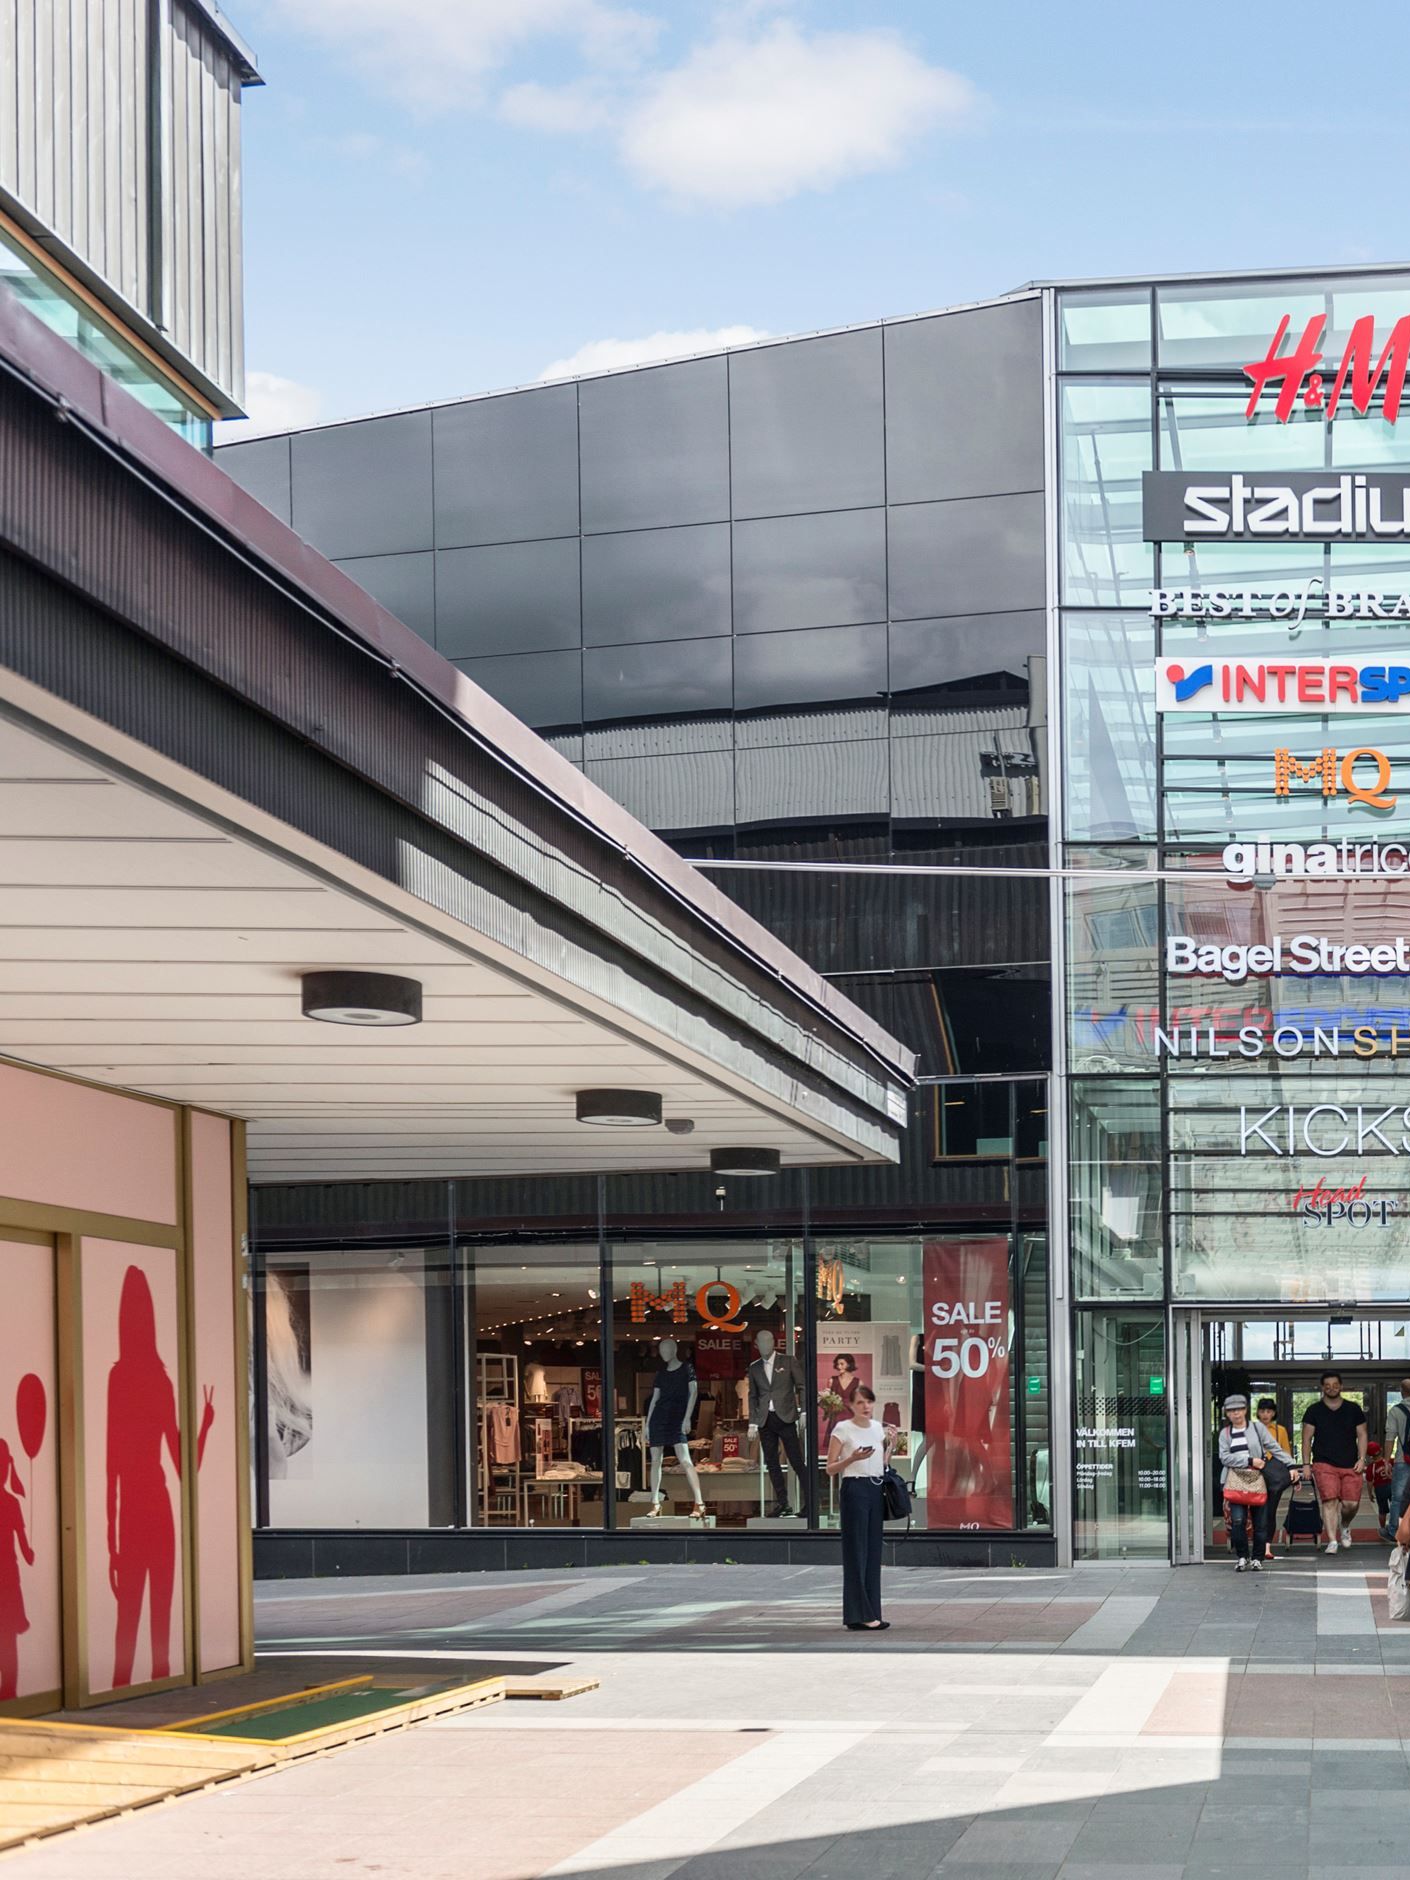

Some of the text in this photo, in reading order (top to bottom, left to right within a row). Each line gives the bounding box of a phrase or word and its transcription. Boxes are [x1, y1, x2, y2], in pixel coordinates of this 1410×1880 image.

[1148, 589, 1262, 618] BEST
[1271, 576, 1323, 631] of
[1274, 747, 1398, 810] MQ
[1166, 935, 1282, 980] Bagel
[1289, 935, 1410, 973] Street
[1292, 1175, 1367, 1210] Head
[1303, 1199, 1400, 1229] SPOT
[629, 1280, 750, 1334] MQ
[931, 1301, 1002, 1326] SALE
[821, 1335, 861, 1345] PARTY
[931, 1336, 1005, 1380] 50%
[585, 1371, 602, 1381] SAL
[1076, 1439, 1086, 1448] IN
[1088, 1439, 1107, 1448] TILL
